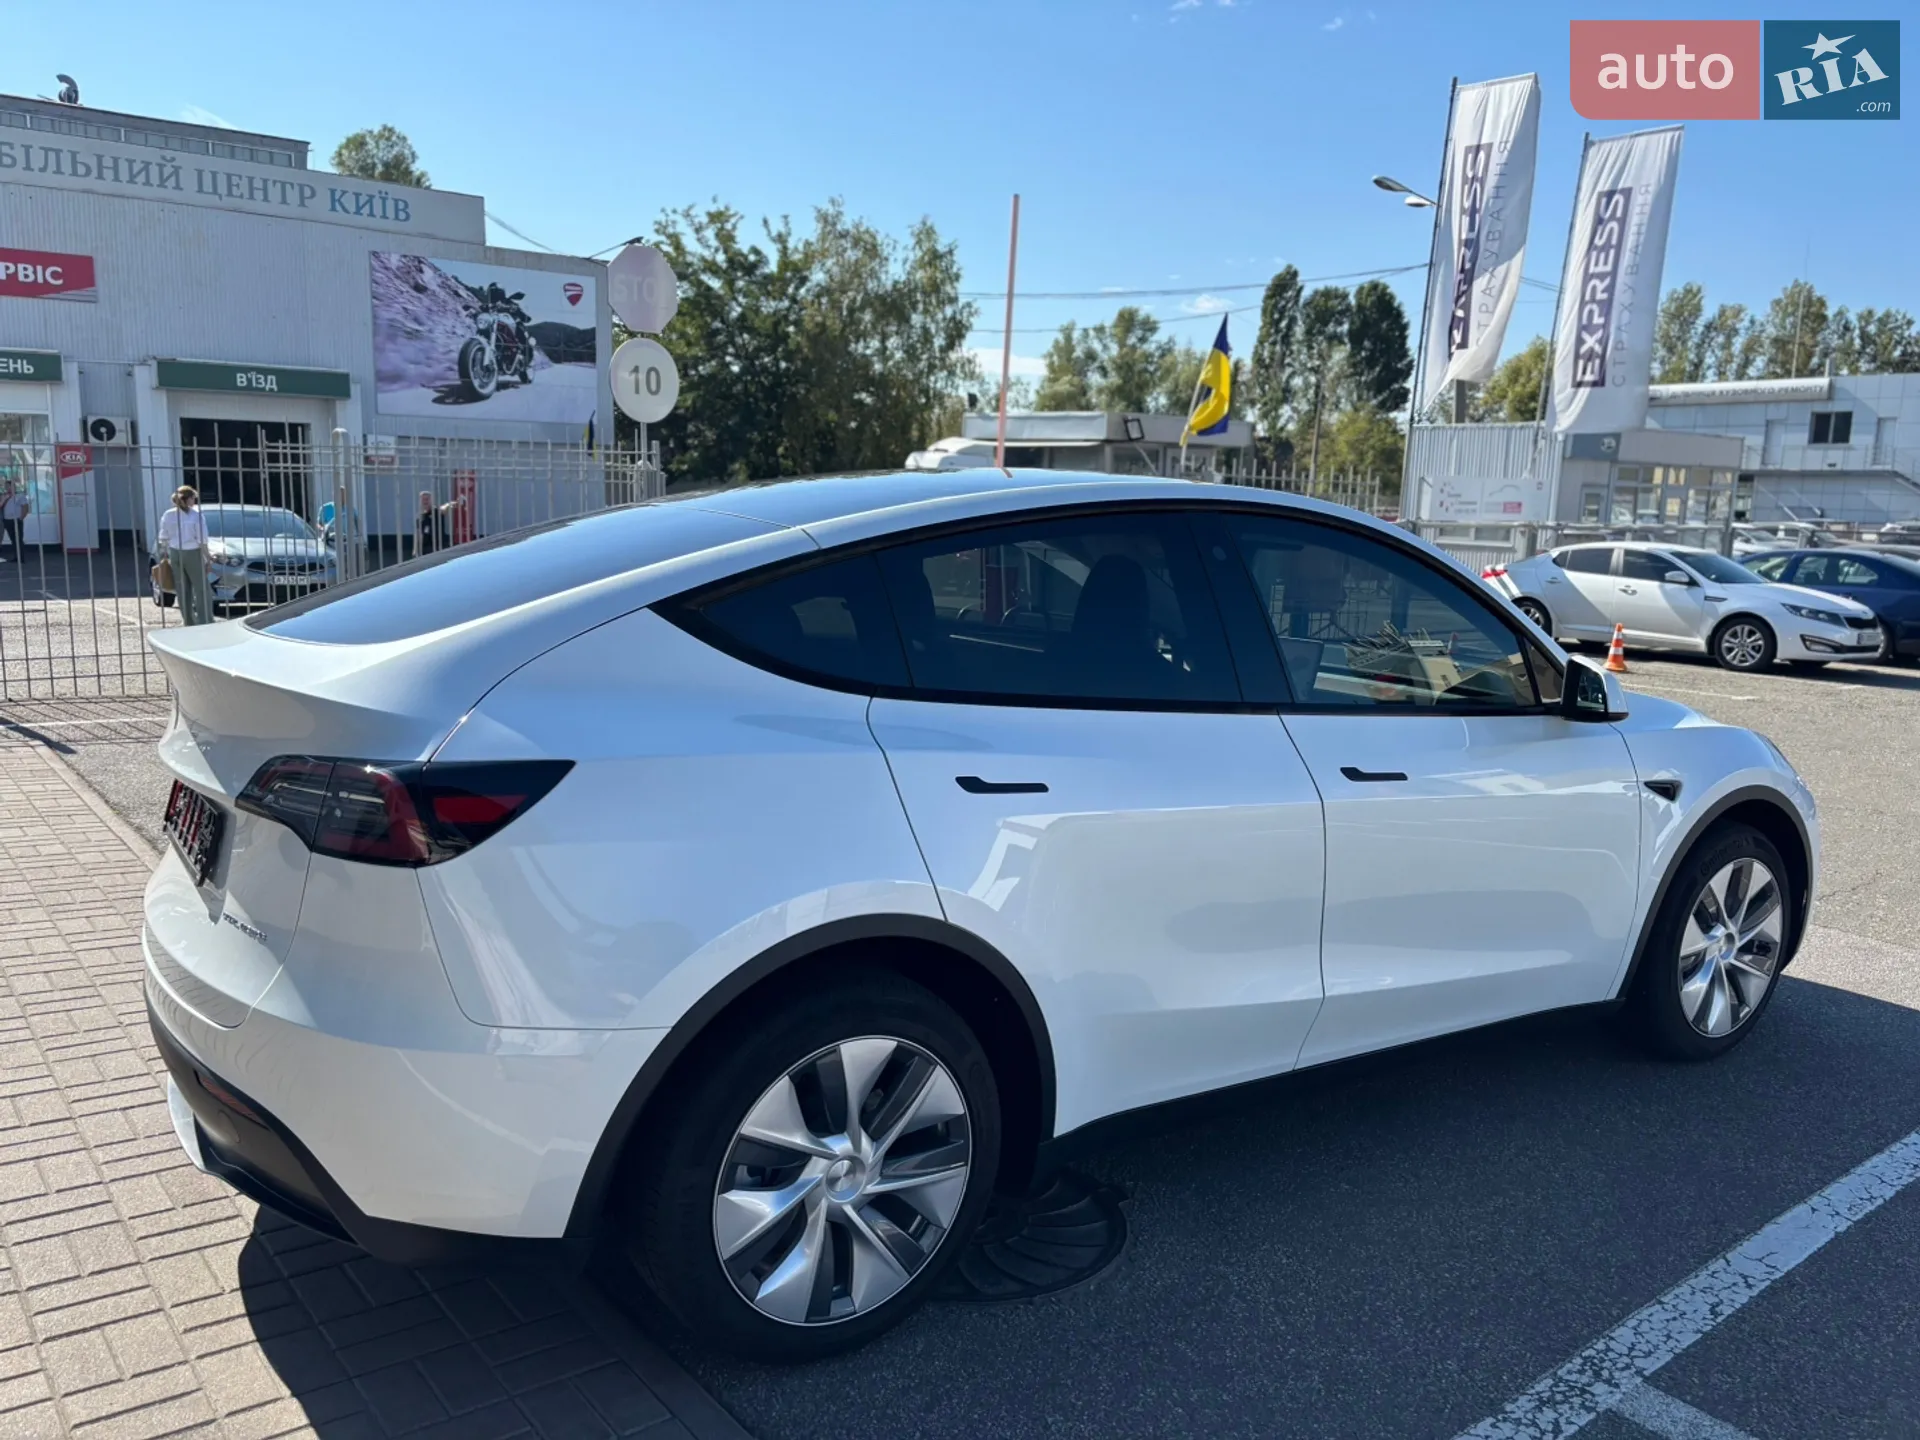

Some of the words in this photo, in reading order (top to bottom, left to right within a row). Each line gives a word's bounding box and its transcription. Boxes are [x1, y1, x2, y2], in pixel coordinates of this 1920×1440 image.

[0, 140, 184, 191] БІЛЬНИЙ
[194, 168, 317, 208] ЦЕНТР
[328, 188, 411, 222] КИЇВ
[0, 261, 64, 285] РВІС
[612, 273, 666, 304] STO
[1576, 192, 1625, 382] EXPRESS
[1611, 184, 1652, 388] СТРАХУВАННЯ
[236, 371, 278, 391] В'ЇЗД
[629, 365, 661, 396] 10
